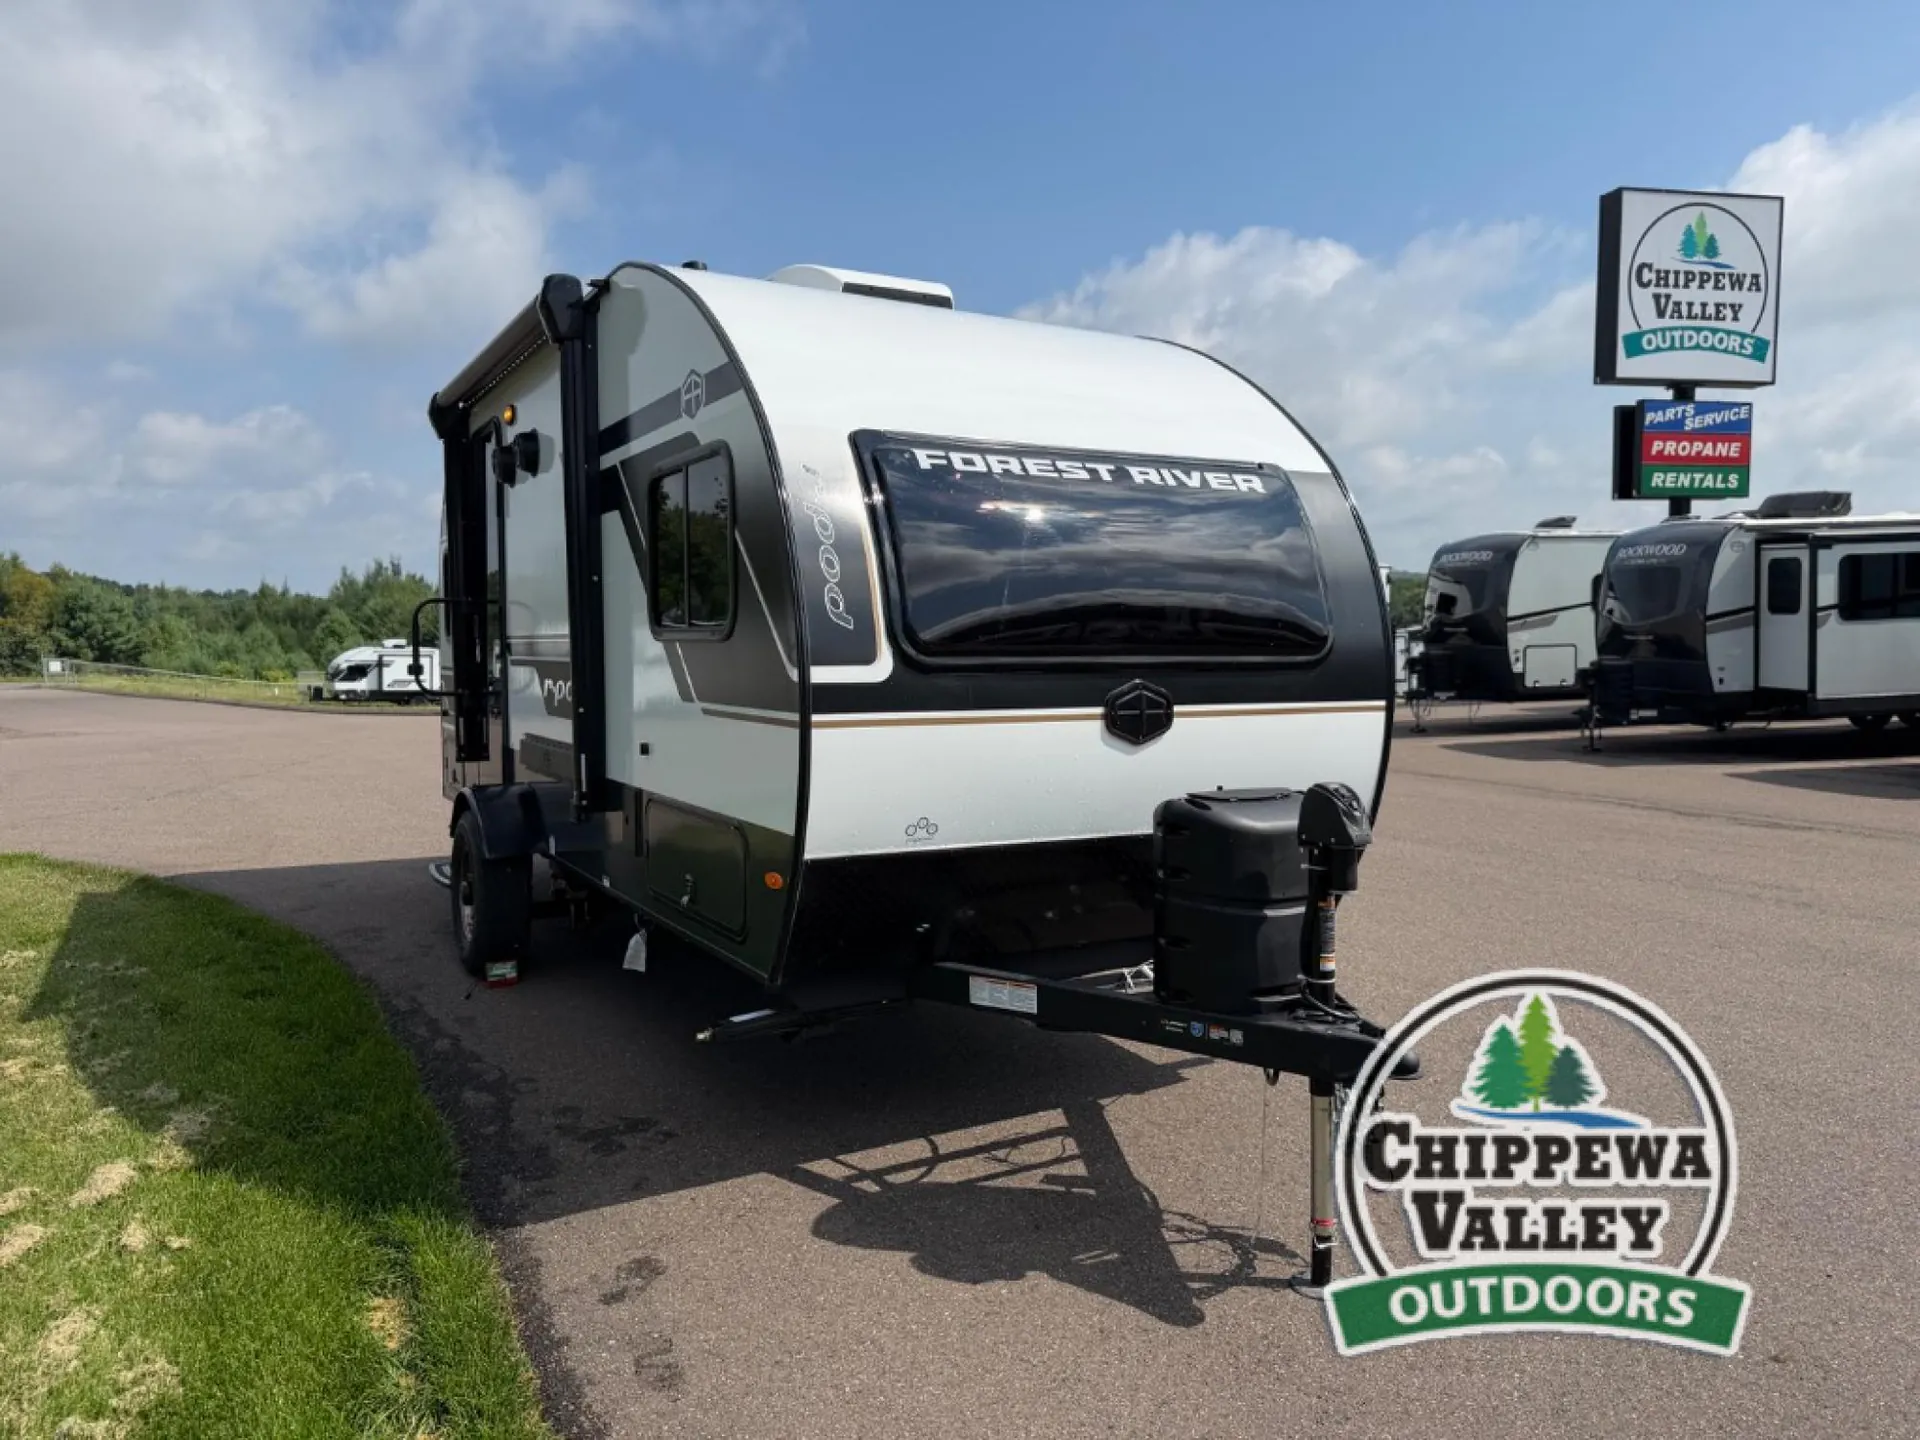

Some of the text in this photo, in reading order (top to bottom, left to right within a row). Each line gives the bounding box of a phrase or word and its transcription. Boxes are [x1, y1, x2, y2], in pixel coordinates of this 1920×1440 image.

[1635, 262, 1762, 292] CHIPPEWA
[1652, 293, 1744, 322] VALLEY
[1641, 331, 1754, 354] OUTDOORS
[1644, 404, 1696, 424] PARTS
[1684, 406, 1750, 431] SERVICE
[1651, 440, 1742, 458] PROPANE
[911, 449, 1267, 494] FOREST RIVER
[1651, 472, 1740, 489] RENTALS
